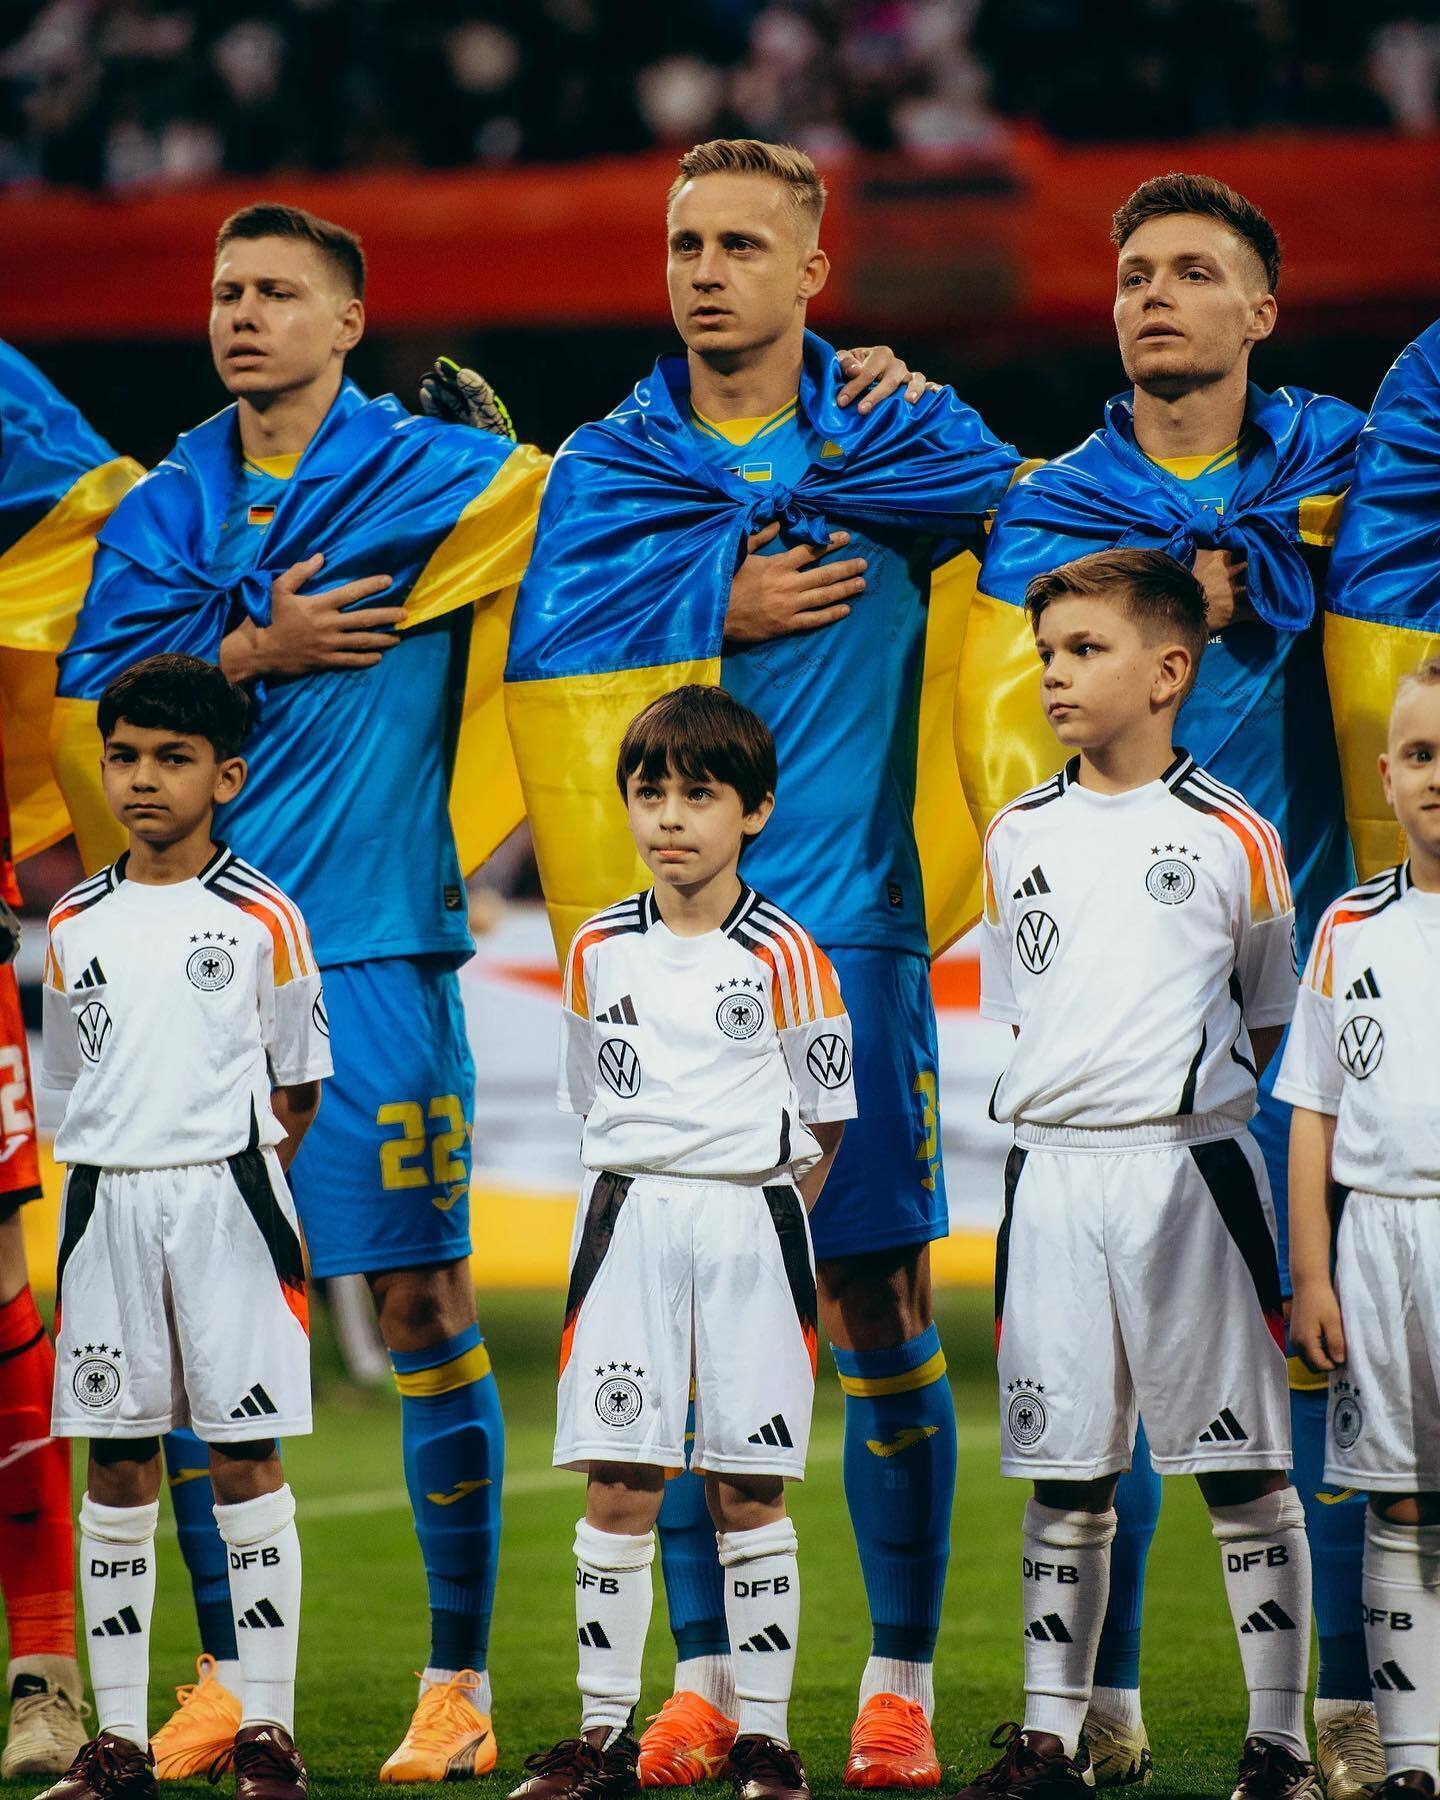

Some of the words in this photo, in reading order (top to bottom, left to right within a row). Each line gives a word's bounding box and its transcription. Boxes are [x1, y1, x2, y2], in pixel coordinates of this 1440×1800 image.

[376, 1095, 467, 1190] 22
[91, 1557, 147, 1579] DFB
[230, 1547, 280, 1570] DFB
[1023, 1557, 1079, 1584] DFB
[1227, 1545, 1289, 1573] DFB
[734, 1576, 790, 1598] DFB
